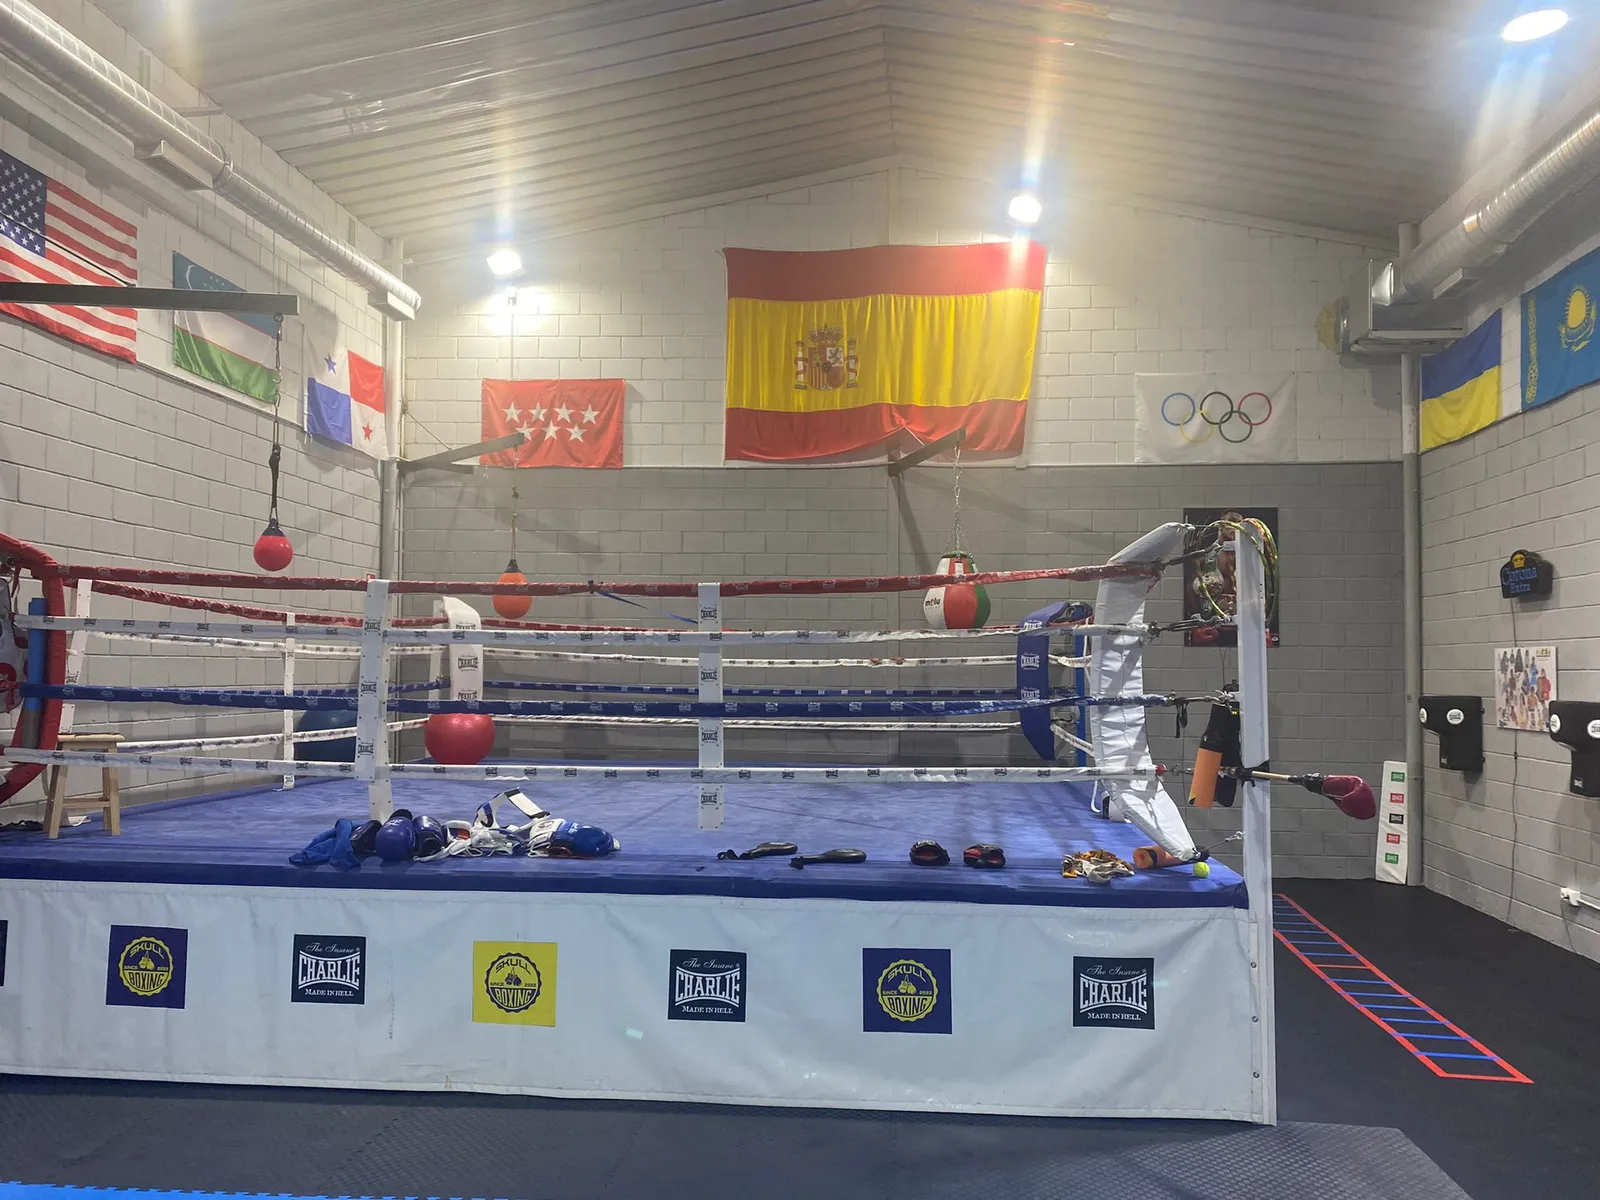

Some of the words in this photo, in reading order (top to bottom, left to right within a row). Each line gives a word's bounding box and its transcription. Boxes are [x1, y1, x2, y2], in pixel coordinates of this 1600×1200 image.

[1502, 567, 1537, 586] Corona
[129, 942, 165, 960] SKULL
[305, 942, 323, 952] The
[325, 944, 354, 953] Insane
[298, 954, 360, 987] CHARLIE
[495, 958, 531, 976] SKULL
[682, 957, 701, 968] The
[703, 959, 733, 969] Insane
[1086, 964, 1106, 976] The
[1108, 965, 1140, 976] Insane
[128, 972, 165, 991] BOXING
[887, 965, 927, 983] SKULL
[304, 988, 326, 996] MADE
[675, 969, 740, 1004] CHARLIE
[1079, 976, 1147, 1011] CHARLIE
[495, 988, 532, 1008] BOXING
[887, 996, 928, 1016] BOXING
[682, 1005, 704, 1013] MADE
[1120, 1013, 1142, 1021] HELL
